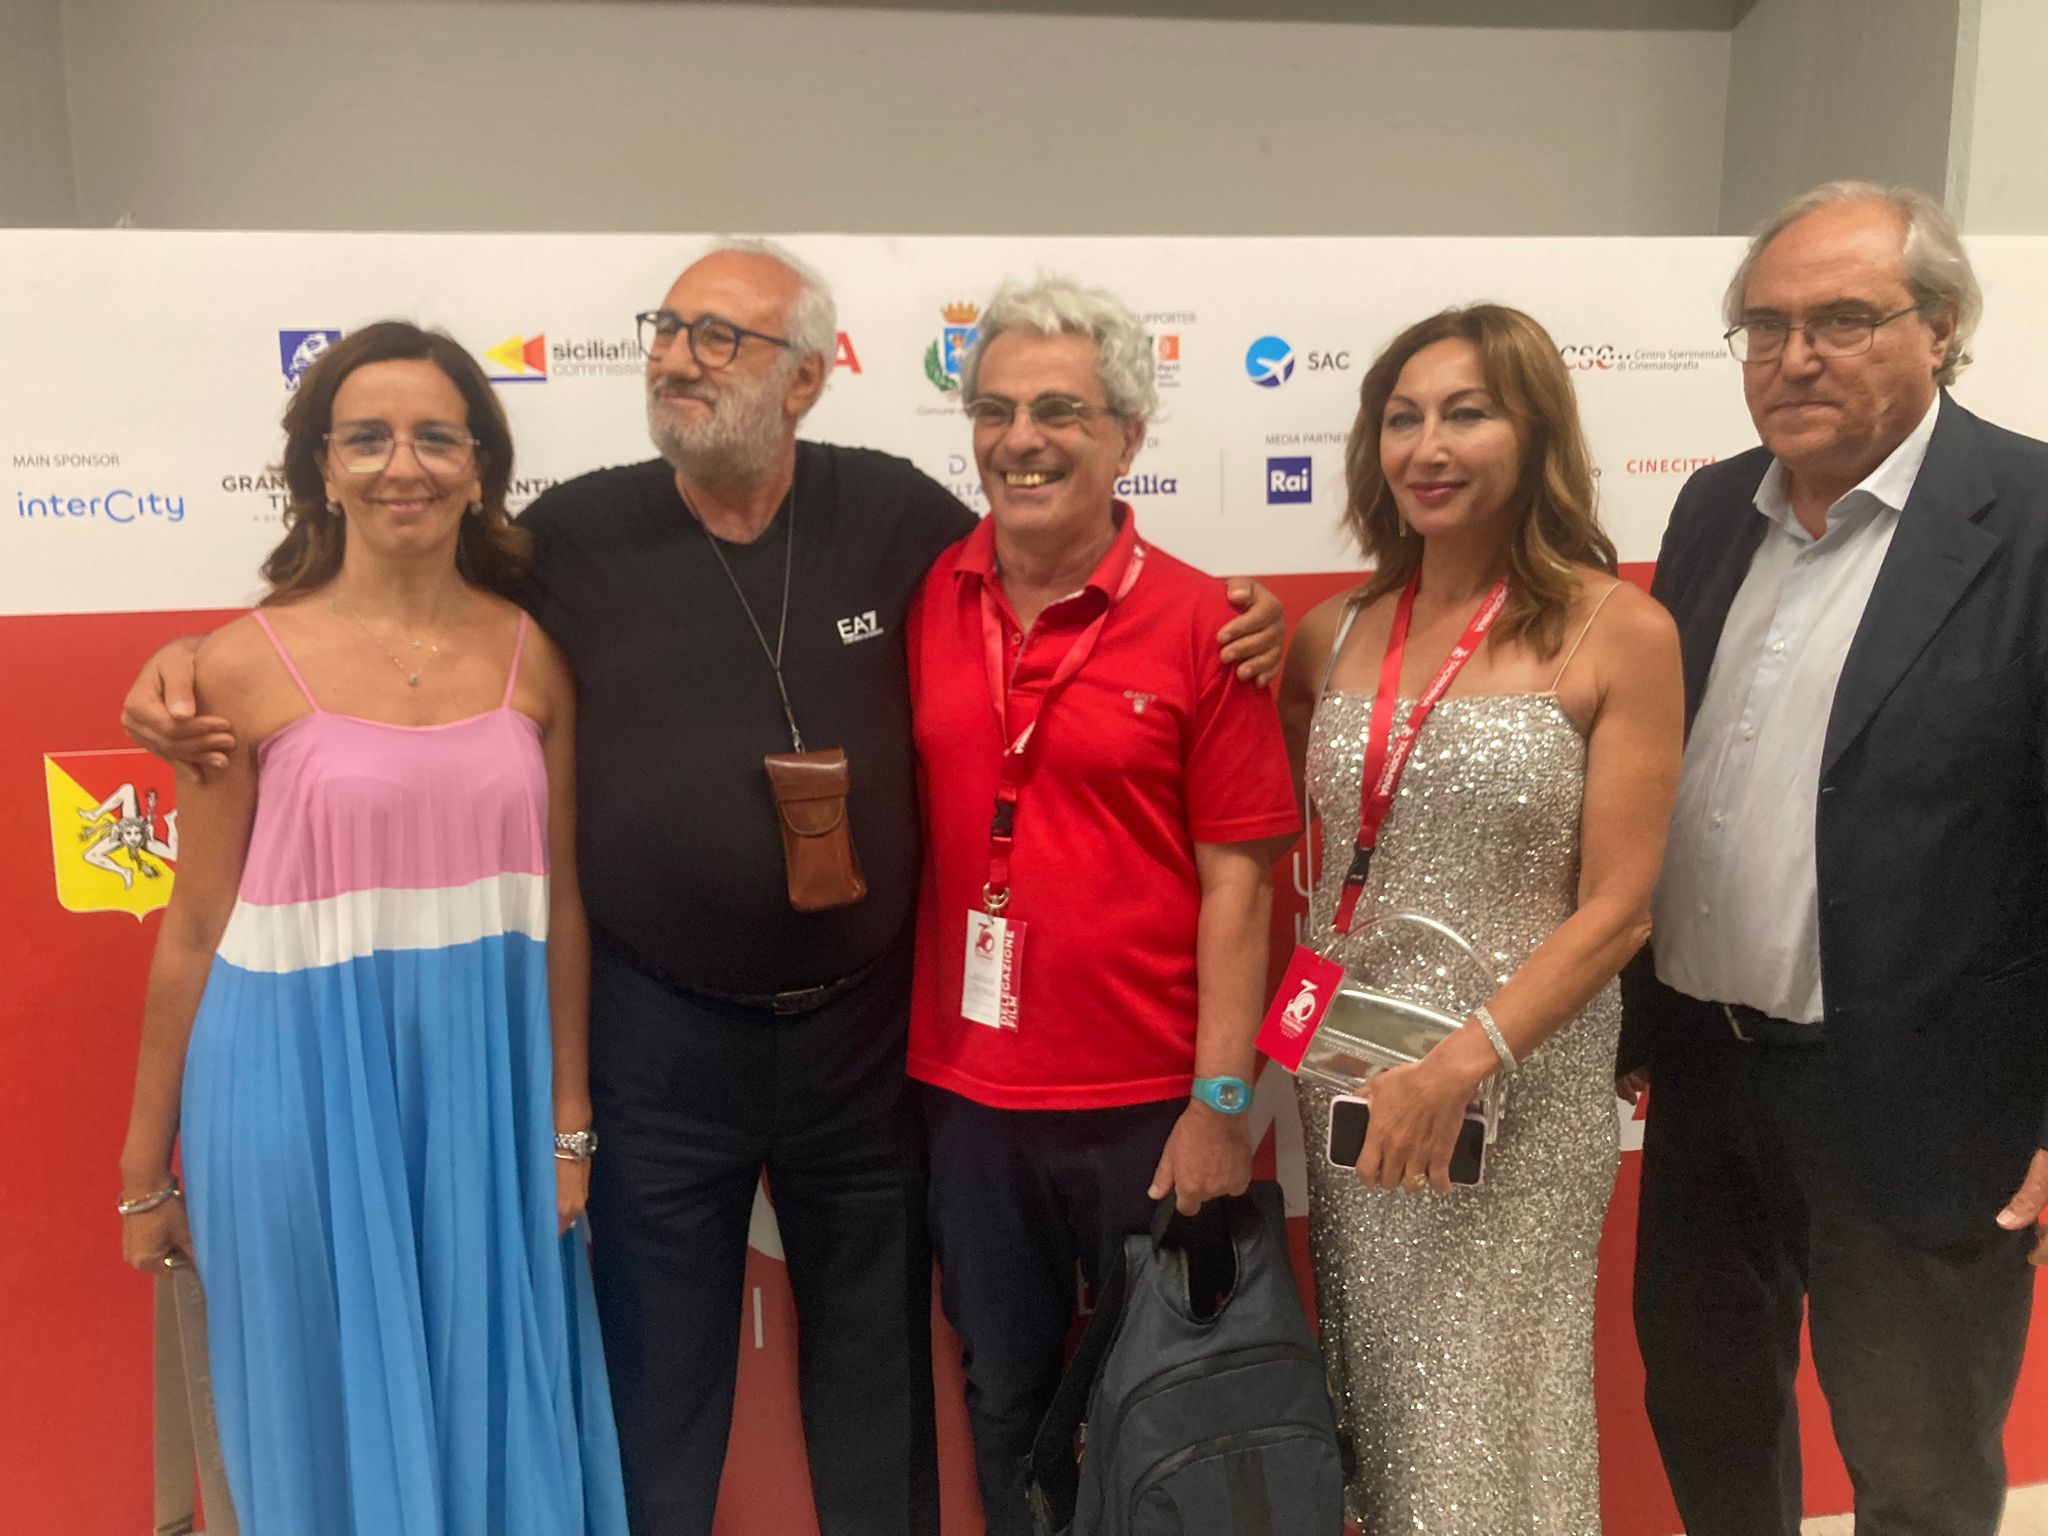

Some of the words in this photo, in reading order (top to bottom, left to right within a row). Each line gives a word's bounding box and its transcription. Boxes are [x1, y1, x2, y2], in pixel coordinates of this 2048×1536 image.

[1307, 352, 1350, 371] SAC
[1634, 349, 1666, 360] Centro
[1668, 347, 1728, 361] Sperimentale
[1628, 360, 1699, 372] Cinematografia
[1265, 432, 1300, 446] MEDIA
[13, 454, 50, 468] MAIN
[53, 453, 120, 468] SPONSOR
[222, 474, 287, 492] GRAN
[1114, 474, 1177, 495] cilia
[1270, 467, 1308, 493] Rai
[17, 489, 185, 524] interCity
[837, 609, 877, 639] EA7
[1001, 930, 1015, 1026] DELEGAZIONE
[1008, 996, 1018, 1027] FILM
